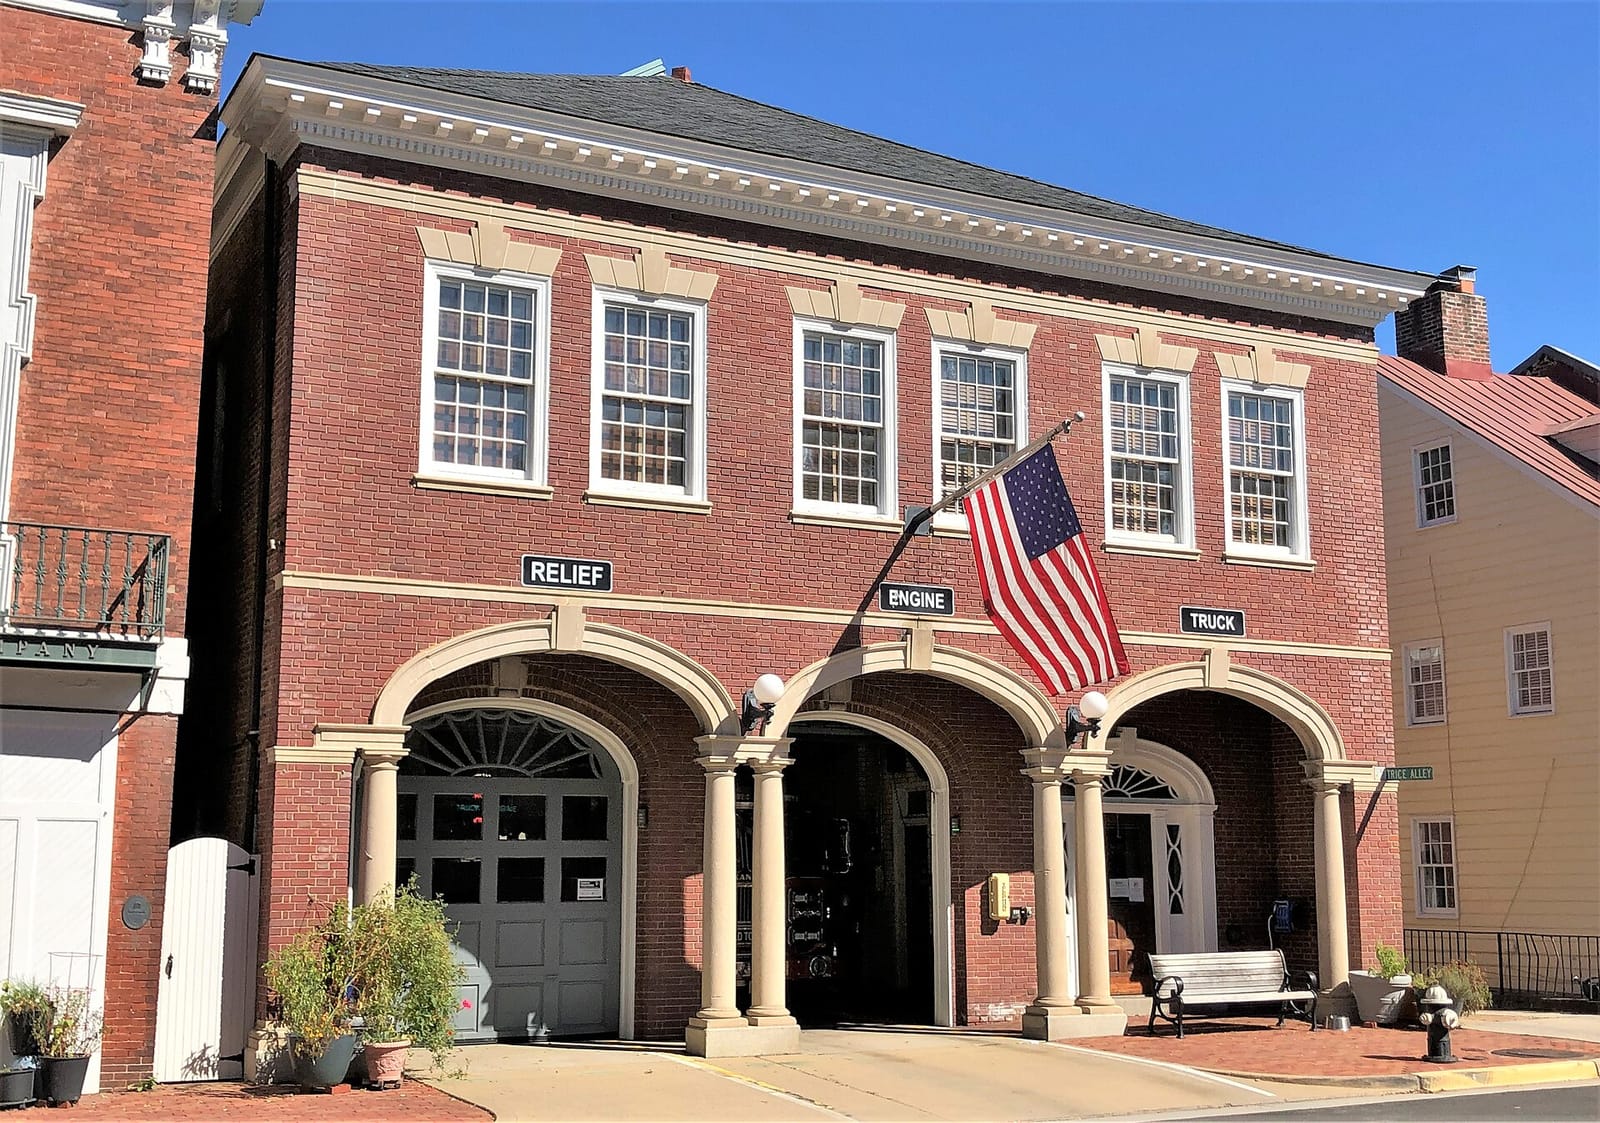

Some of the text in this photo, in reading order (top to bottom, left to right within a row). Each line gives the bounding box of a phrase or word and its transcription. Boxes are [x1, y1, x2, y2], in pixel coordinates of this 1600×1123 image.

[530, 561, 604, 586] RELIEF
[888, 589, 945, 610] ENGINE
[1189, 612, 1236, 631] TRUCK
[1409, 768, 1432, 779] ALLEY
